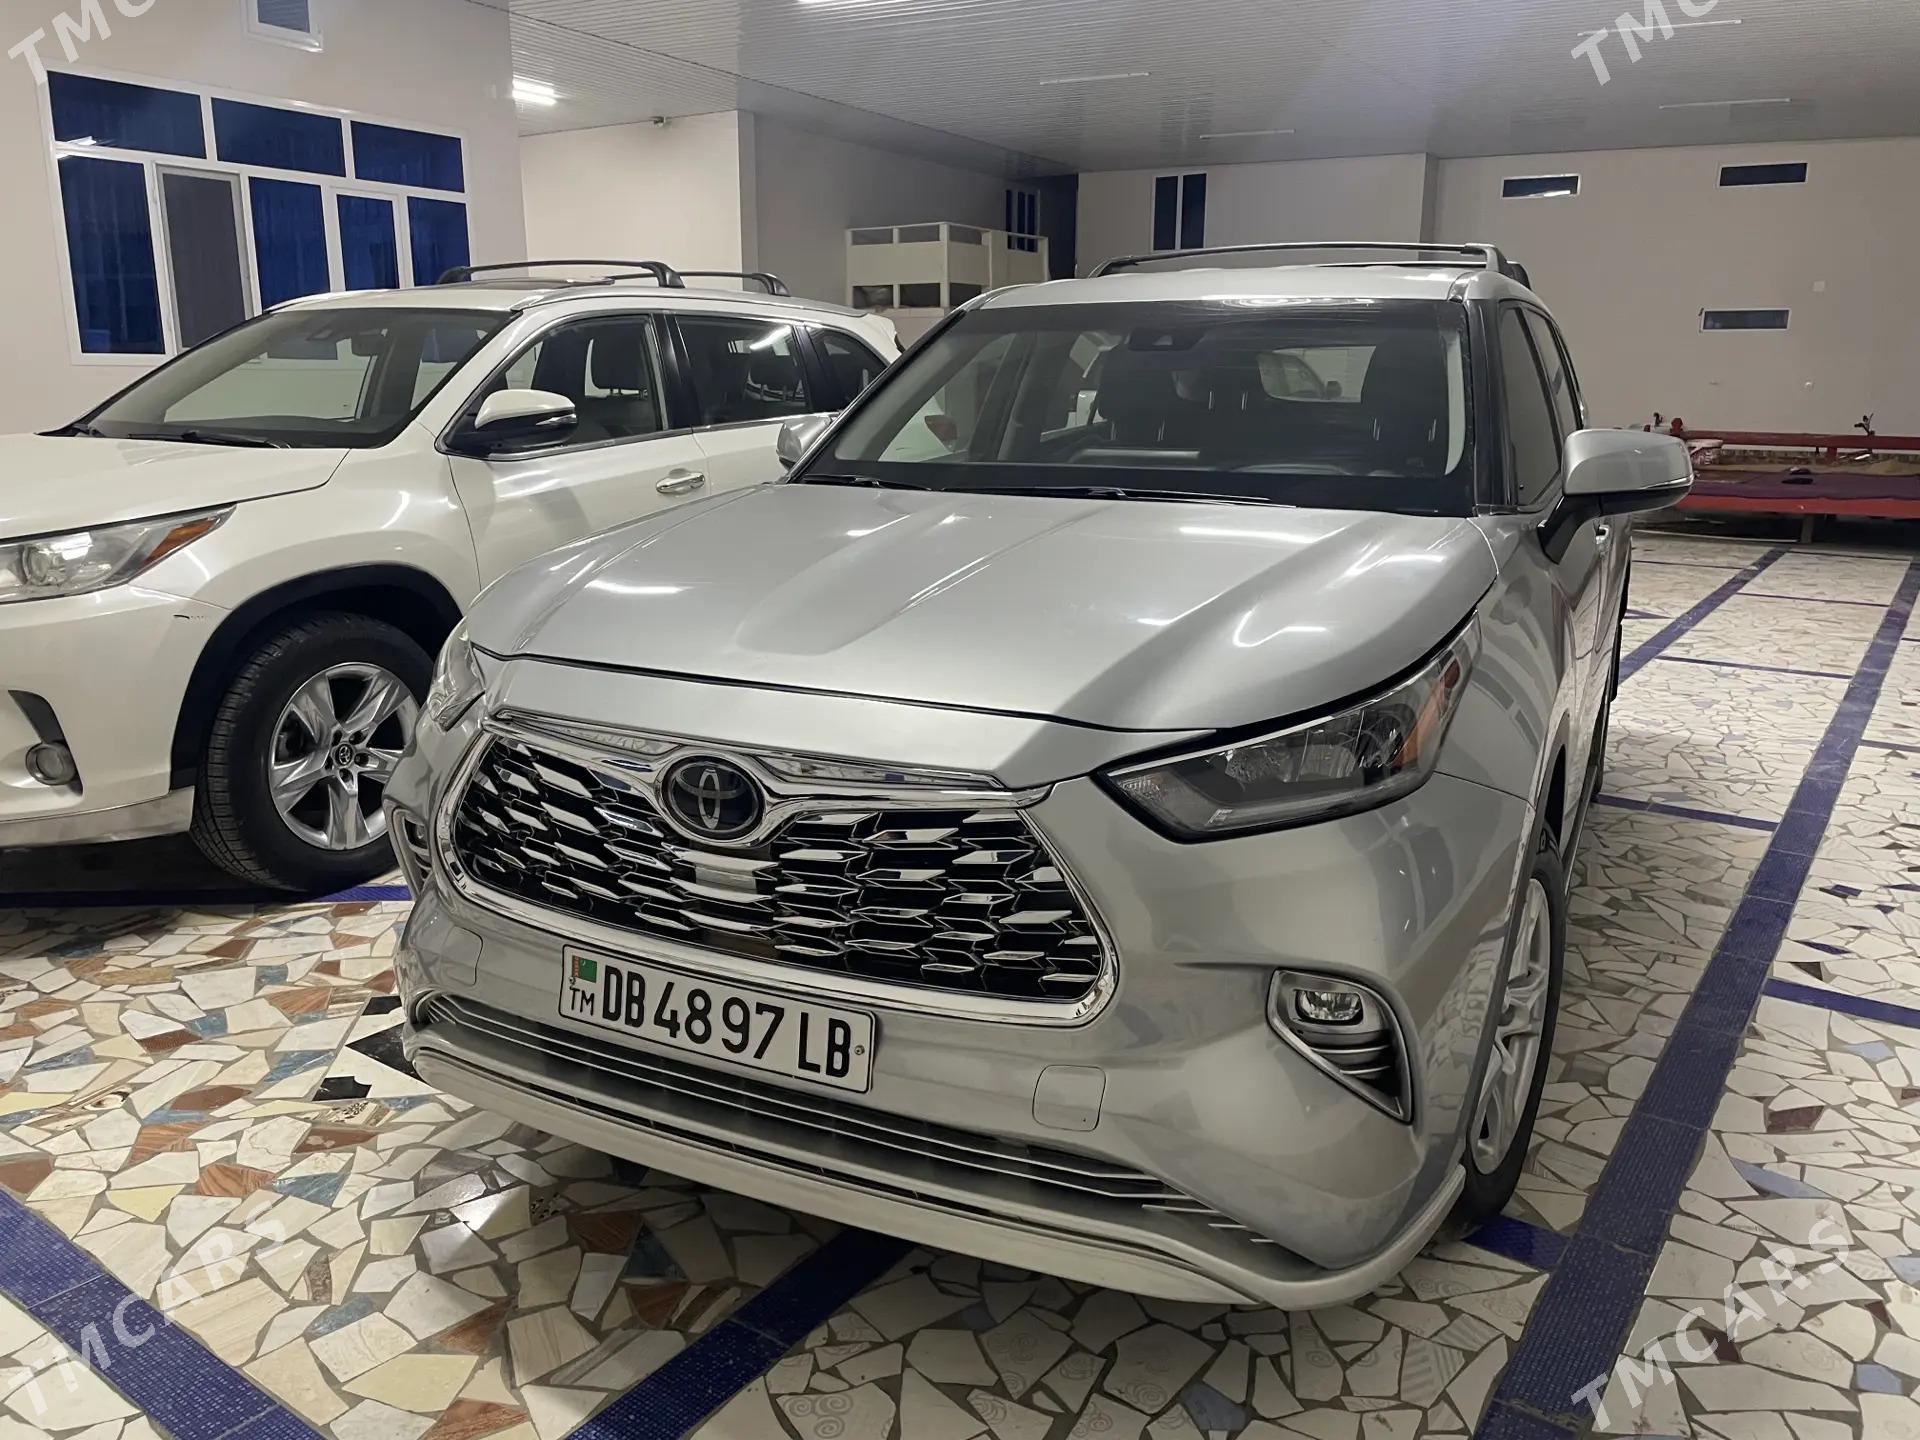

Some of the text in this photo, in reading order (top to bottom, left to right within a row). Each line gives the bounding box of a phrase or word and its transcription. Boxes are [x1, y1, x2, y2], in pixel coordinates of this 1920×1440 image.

[569, 986, 595, 1017] TM
[602, 965, 646, 1028] DB
[798, 1012, 851, 1078] LB
